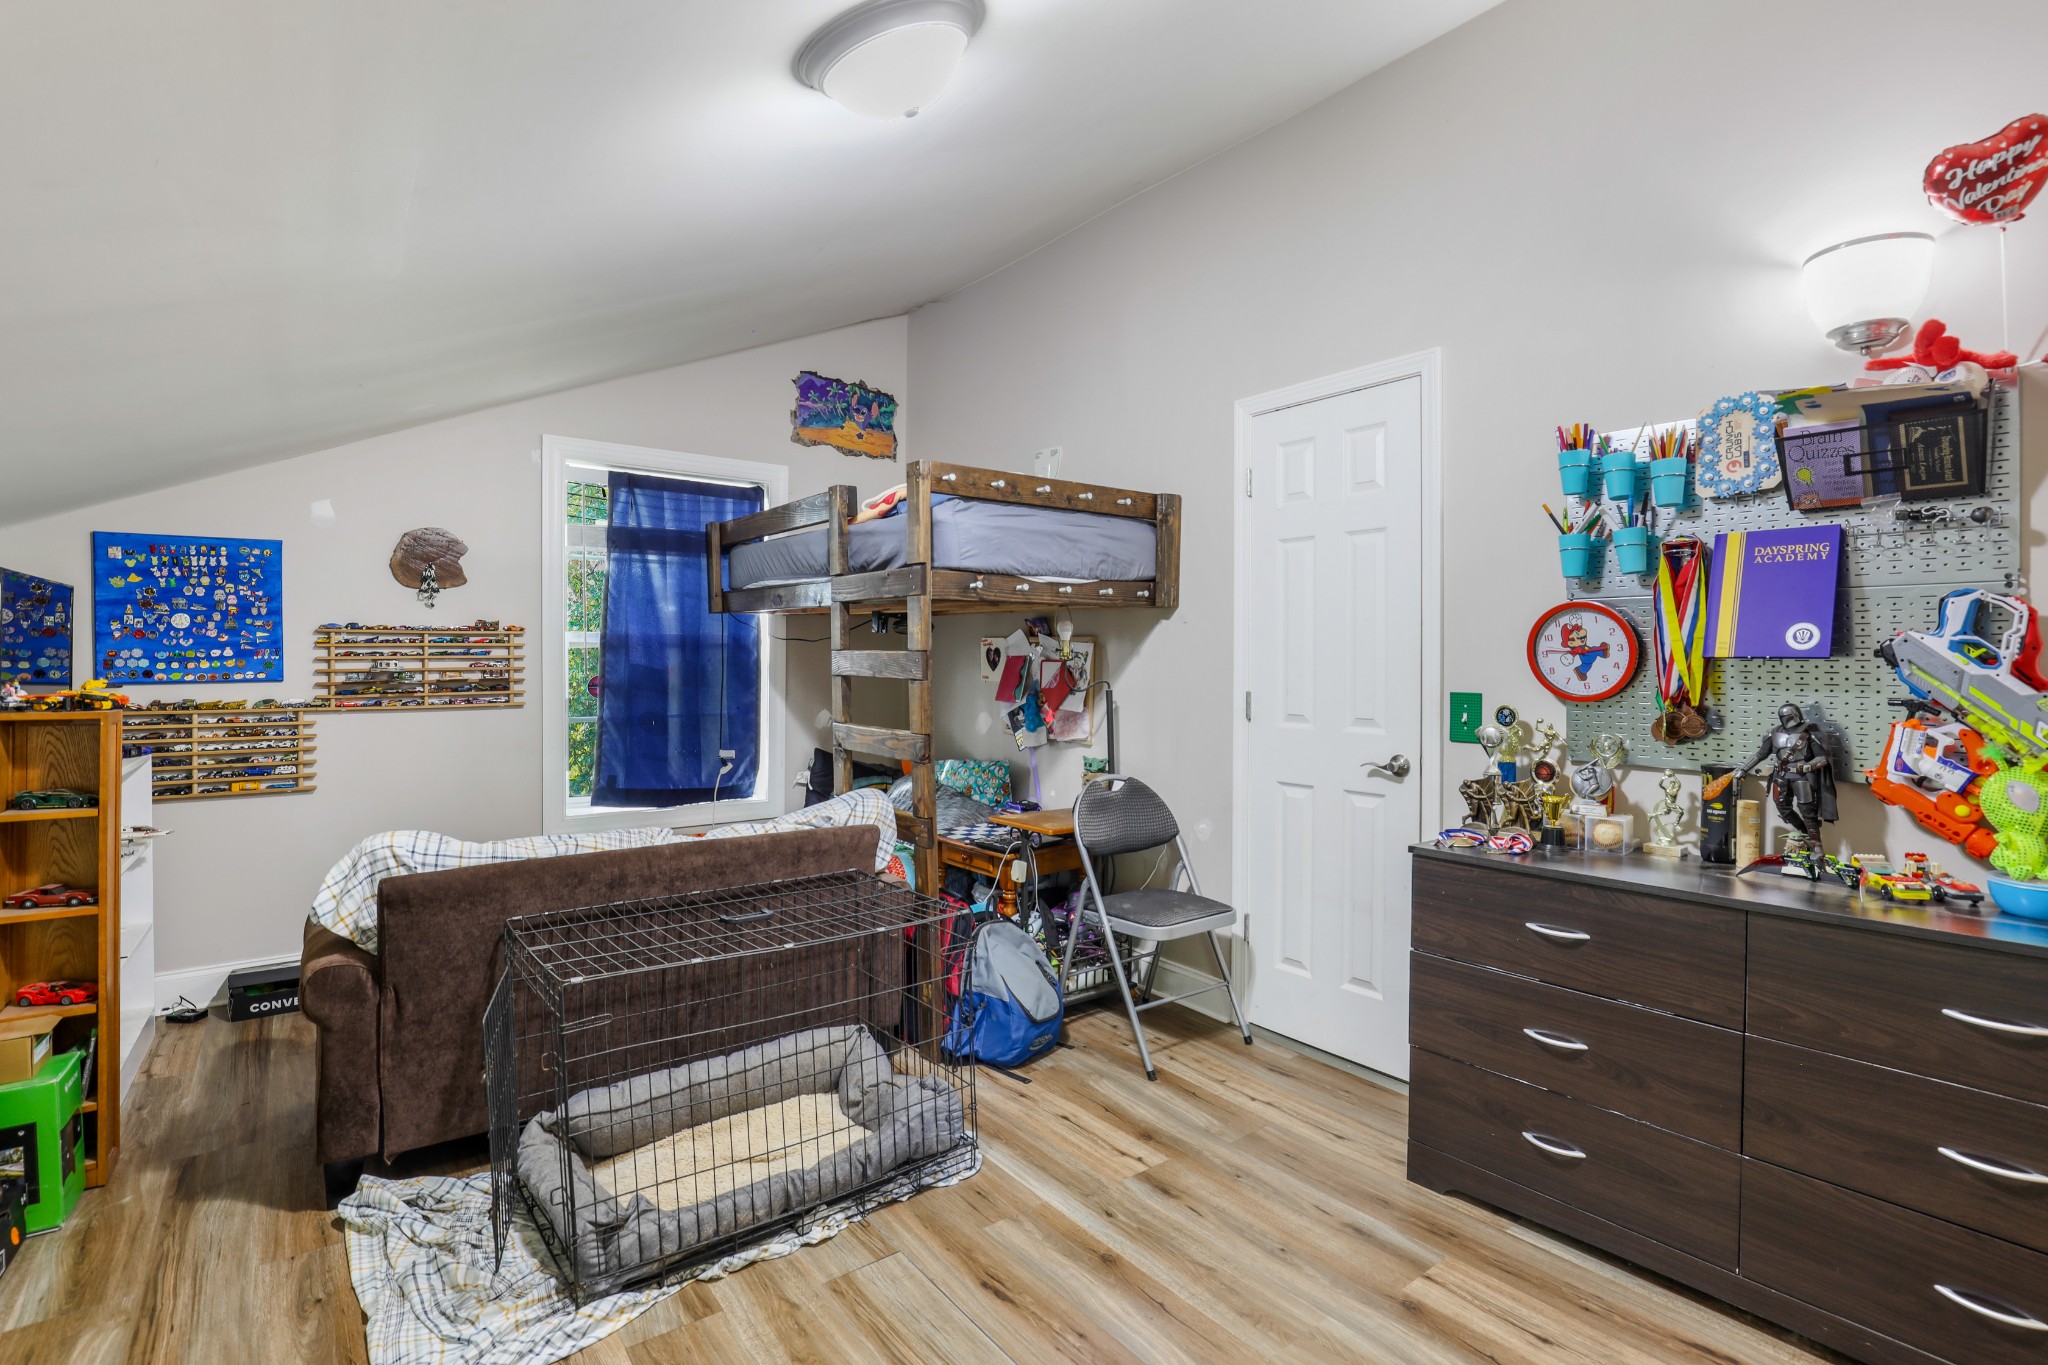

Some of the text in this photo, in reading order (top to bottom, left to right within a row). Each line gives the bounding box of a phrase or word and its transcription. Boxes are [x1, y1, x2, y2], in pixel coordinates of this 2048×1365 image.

[1945, 135, 2043, 189] Happy
[1976, 180, 2033, 213] Day
[1725, 420, 1734, 460] CRUNCH
[1734, 432, 1742, 458] LABS
[1788, 445, 1855, 463] Quizzes
[1754, 542, 1830, 556] DAYSPRING
[1754, 551, 1829, 563] ACADEMY
[1544, 634, 1554, 642] 10
[1609, 627, 1616, 636] 2
[1616, 643, 1624, 652] 3
[1549, 667, 1556, 675] 8
[1613, 662, 1620, 670] 4
[1601, 674, 1609, 683] 5
[1583, 682, 1591, 690] 6
[1916, 732, 1926, 755] ELITE
[249, 996, 299, 1013] CONVE
